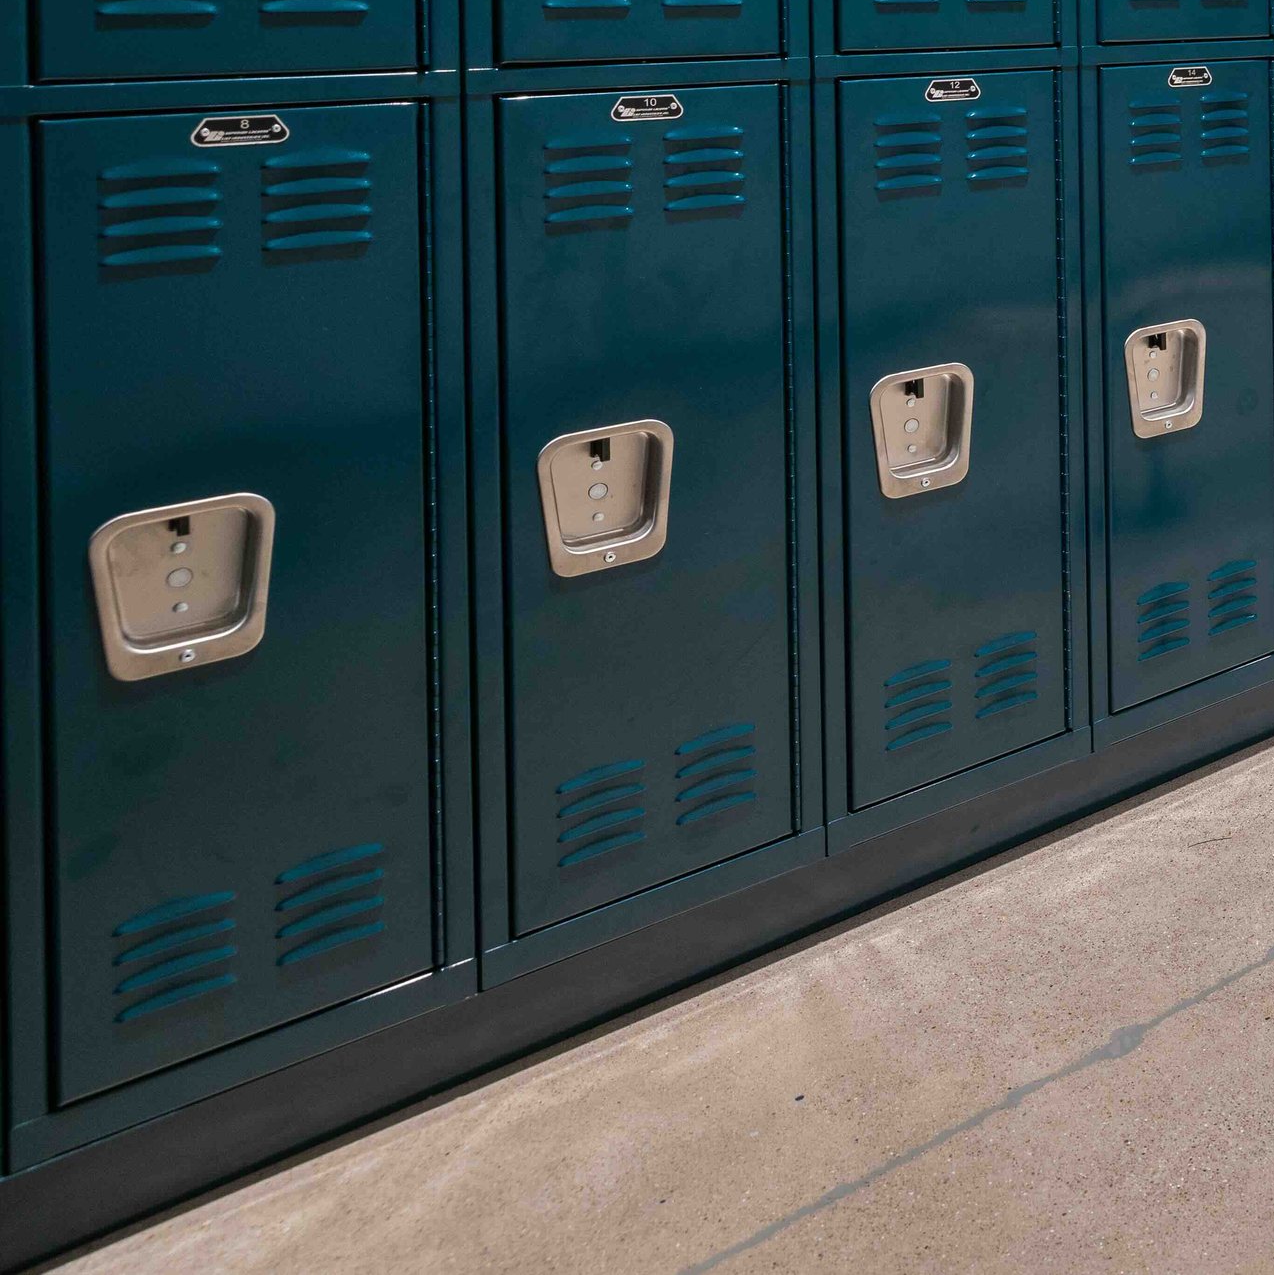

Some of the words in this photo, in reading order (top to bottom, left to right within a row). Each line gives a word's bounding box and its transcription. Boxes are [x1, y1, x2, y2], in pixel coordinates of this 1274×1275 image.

[950, 81, 960, 89] 12
[643, 97, 657, 107] 10
[240, 119, 250, 129] 8
